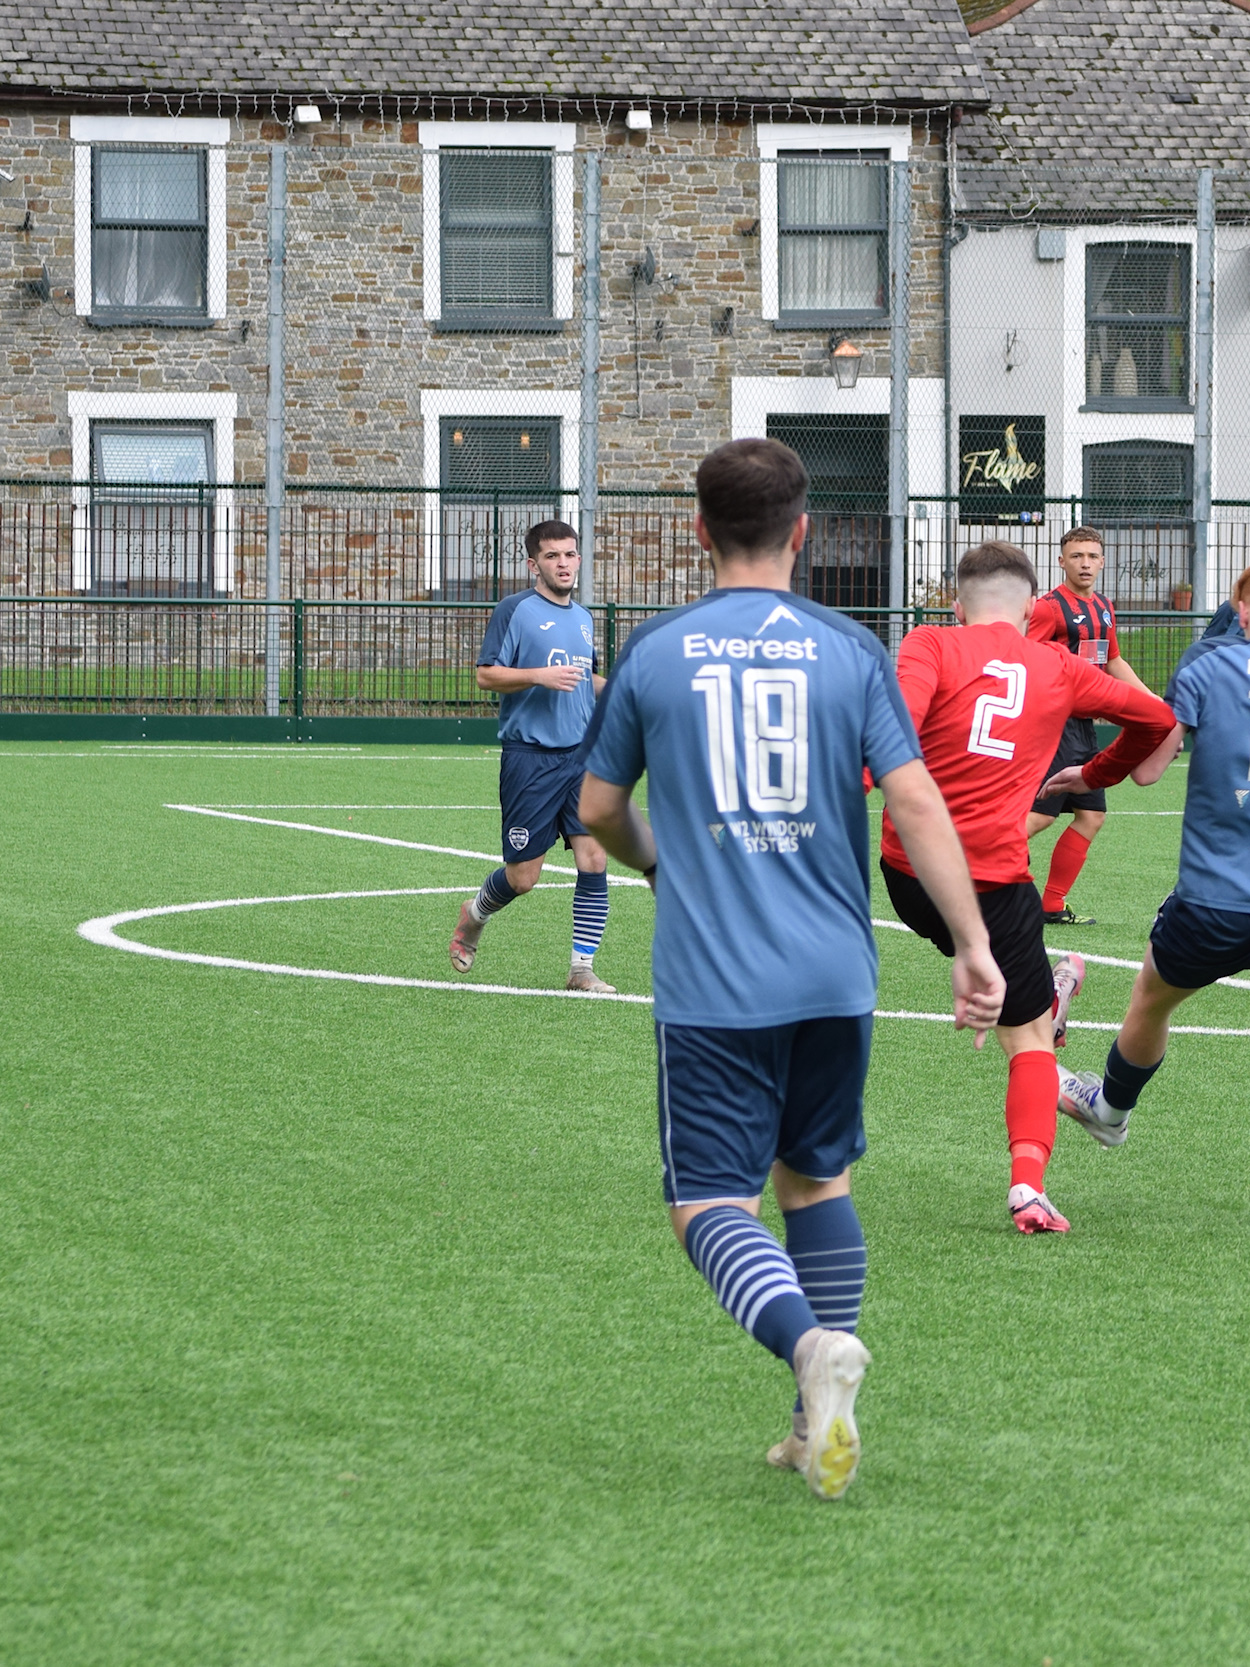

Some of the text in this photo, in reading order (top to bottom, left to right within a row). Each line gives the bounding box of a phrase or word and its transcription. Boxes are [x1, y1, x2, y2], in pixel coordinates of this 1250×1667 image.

[963, 448, 1042, 488] Flame
[683, 633, 818, 661] Everest
[967, 659, 1027, 761] 2
[691, 664, 808, 815] 18
[728, 820, 817, 838] W2 WINDOW
[743, 835, 799, 853] SYSTEMS
